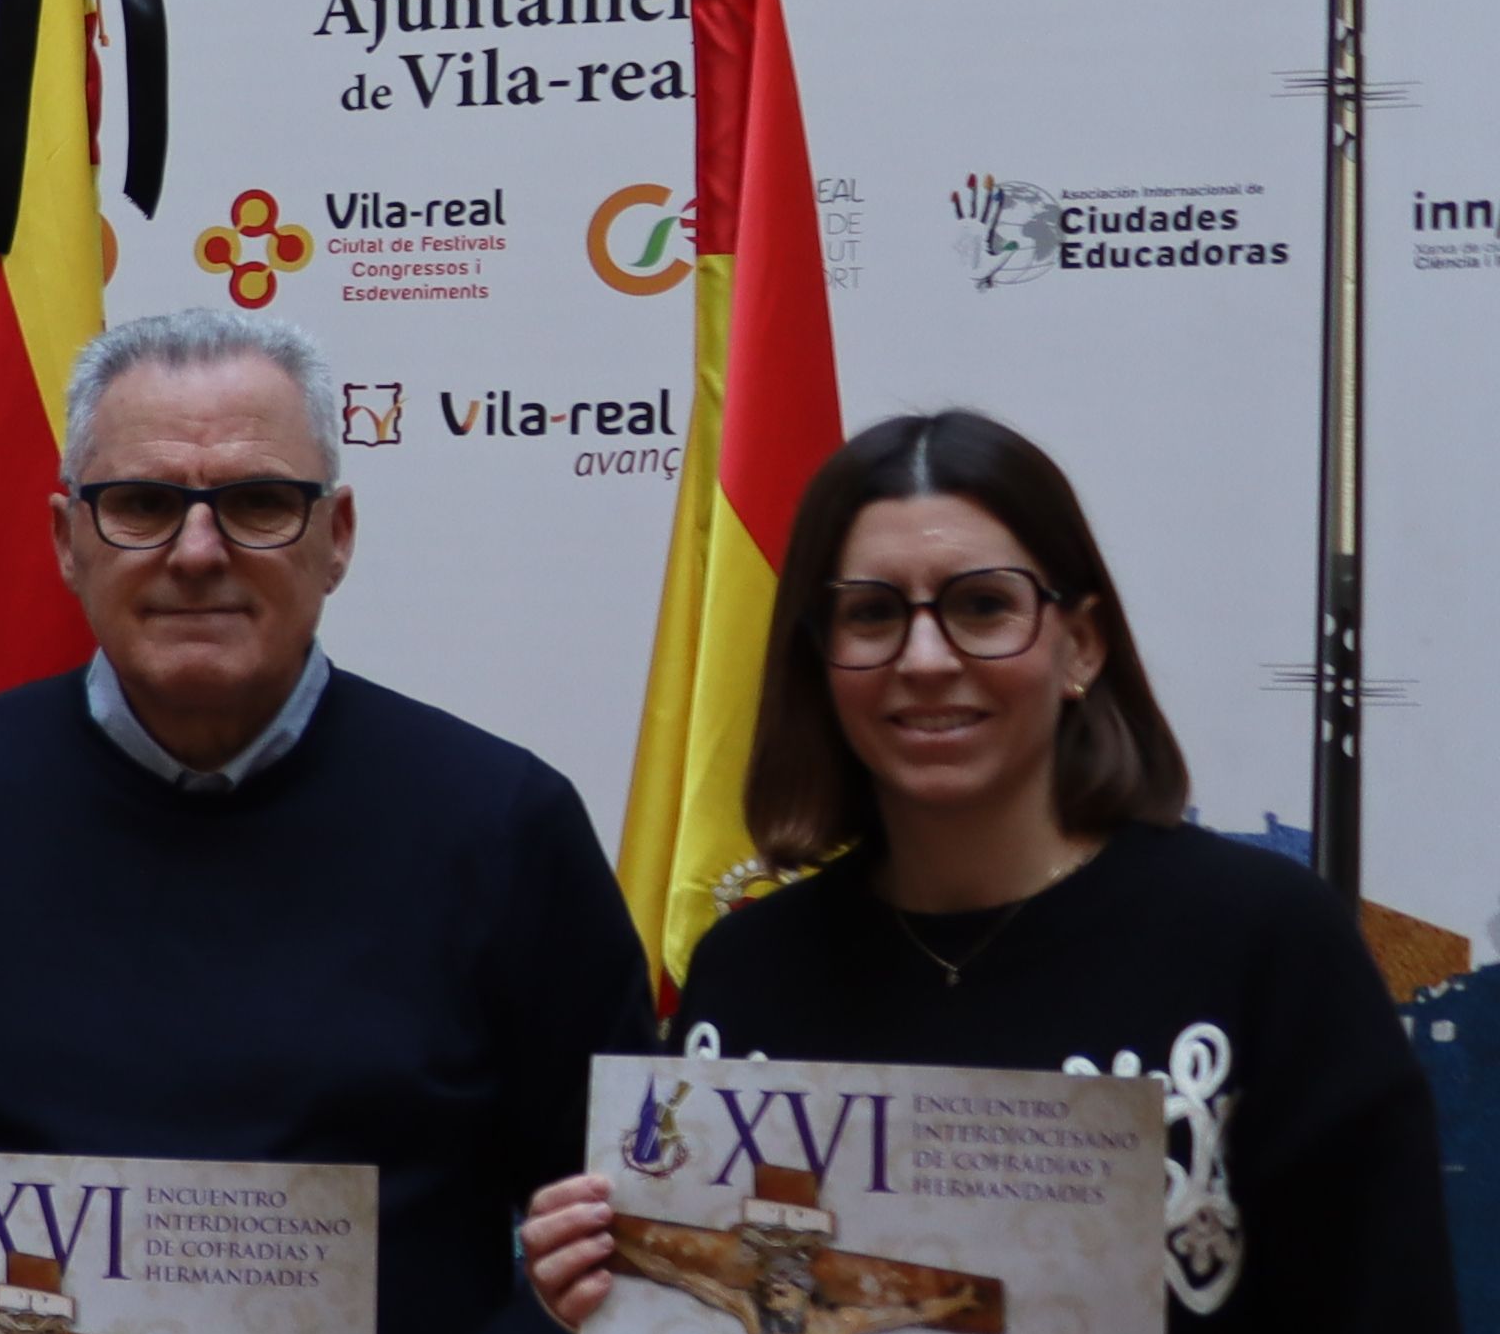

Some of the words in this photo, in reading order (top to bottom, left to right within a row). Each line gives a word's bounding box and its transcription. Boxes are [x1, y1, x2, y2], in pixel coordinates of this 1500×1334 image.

[341, 74, 392, 111] de
[401, 51, 696, 110] Vila-rea
[1141, 185, 1241, 198] Internacional
[1244, 183, 1264, 195] de
[325, 188, 507, 229] Vila-real
[1058, 204, 1239, 235] Ciudades
[827, 212, 864, 235] DE
[327, 237, 384, 255] Ciutat
[390, 236, 414, 254] de
[420, 233, 507, 253] Festivals
[1058, 239, 1290, 270] Educadoras
[351, 259, 466, 281] Congressos
[474, 259, 482, 276] i
[342, 281, 490, 301] Esdeveniments
[439, 388, 678, 437] Vila-real
[574, 446, 681, 481] avanç
[711, 1089, 896, 1192] XVI
[147, 1188, 285, 1209] ENCUENTRO
[147, 1212, 351, 1237] INTERDIOCESANO
[146, 1238, 174, 1255] DE
[312, 1245, 327, 1260] Y
[145, 1264, 317, 1287] HERMANDADES
